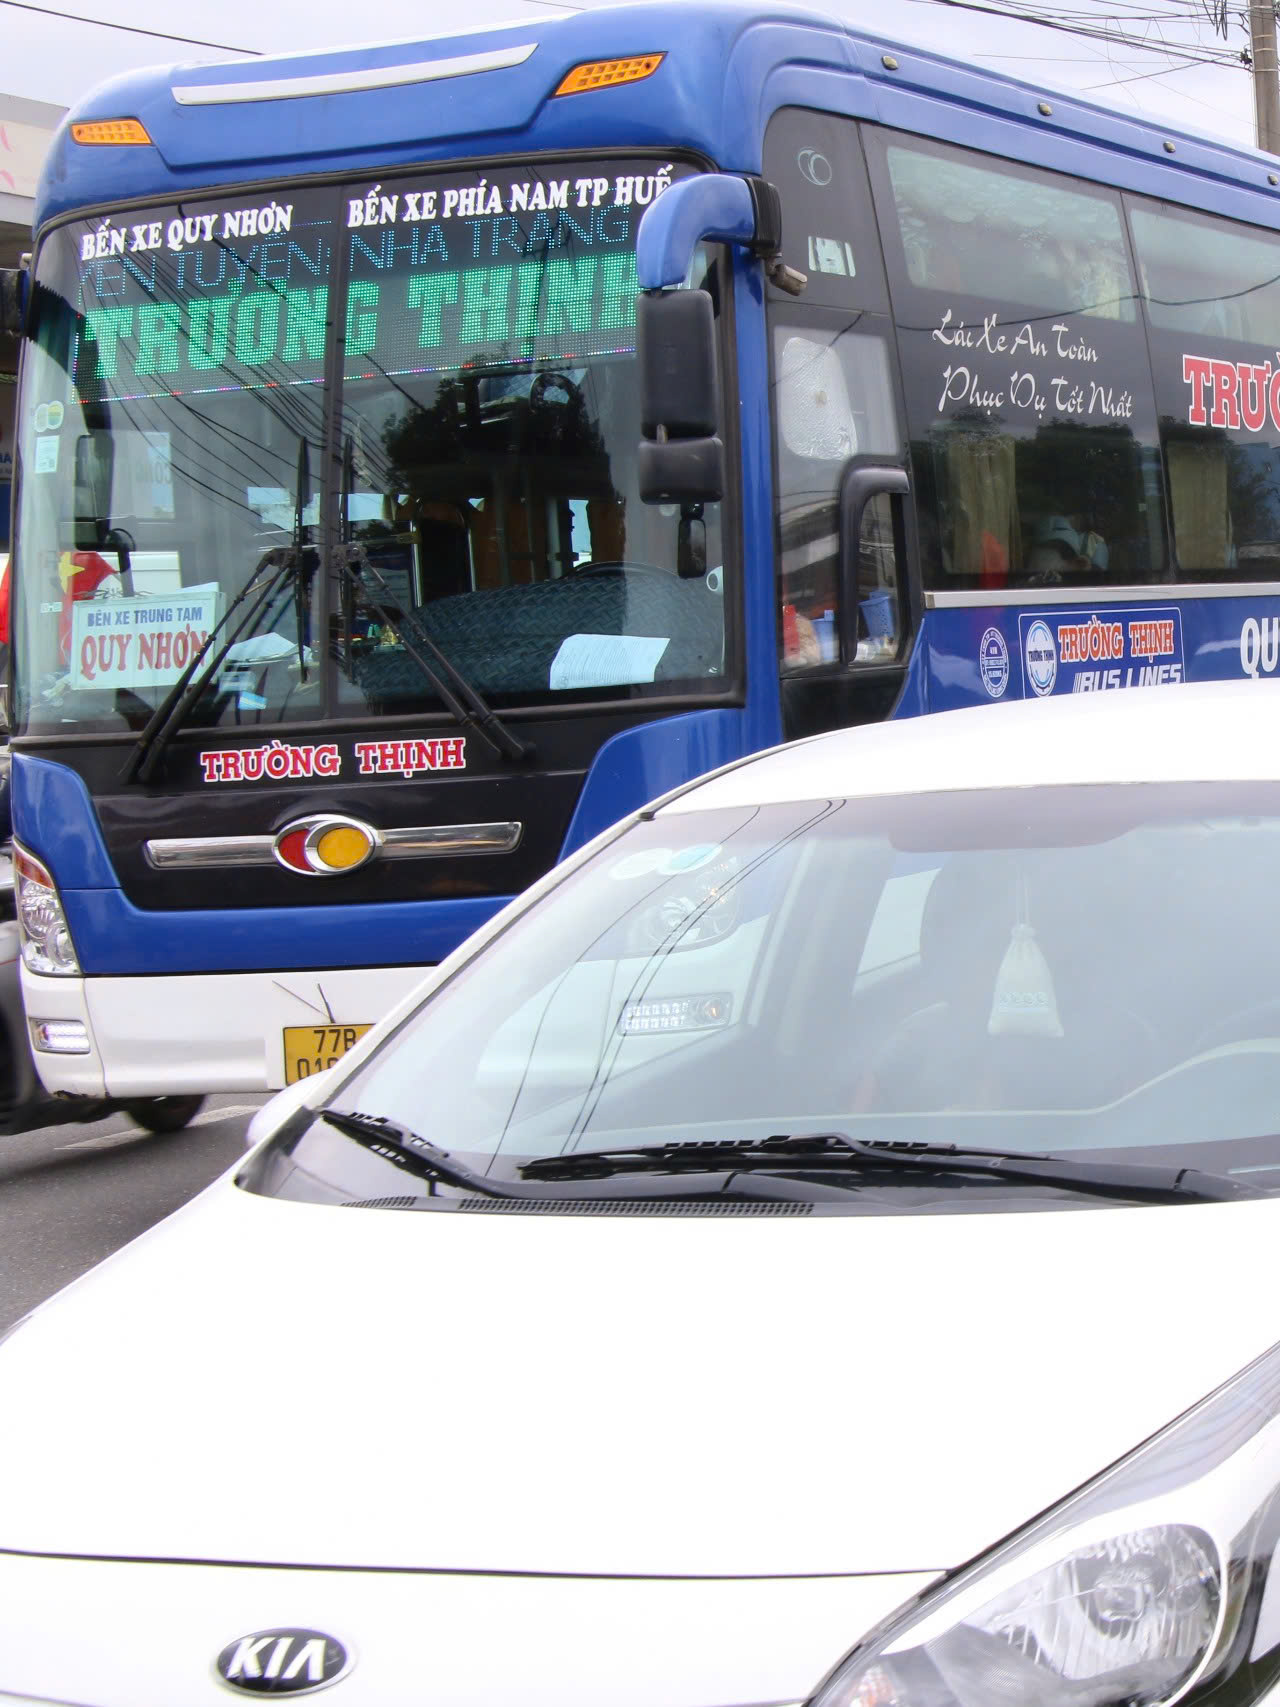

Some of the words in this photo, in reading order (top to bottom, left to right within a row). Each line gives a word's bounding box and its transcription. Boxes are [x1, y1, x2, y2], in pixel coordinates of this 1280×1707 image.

[347, 184, 399, 228] BẾN
[402, 191, 437, 222] XE
[442, 179, 503, 218] PHÍA
[510, 179, 570, 212] NAM
[575, 177, 608, 207] TP
[81, 218, 127, 261] BẾN
[130, 222, 162, 252] XE
[167, 214, 218, 251] QUY
[223, 201, 293, 239] NHƠN
[349, 224, 449, 272] NHA
[465, 203, 630, 259] TRANG
[976, 313, 1008, 354] Xe
[1010, 324, 1049, 357] An
[1051, 323, 1098, 362] Toàn
[938, 365, 1004, 415] Phục
[1051, 376, 1084, 414] Tốt
[1088, 381, 1133, 418] Nhất
[114, 610, 131, 625] XE
[133, 609, 173, 624] TRUNG
[1058, 615, 1123, 663] TRƯỜNG
[1128, 620, 1174, 664] THỊNH
[80, 634, 132, 681] QUY
[138, 623, 208, 670] NHƠN
[1076, 669, 1121, 693] BUS
[200, 739, 341, 782] TRƯỜNG
[355, 737, 466, 778] THỊNH
[313, 1028, 357, 1054] 77B
[226, 1636, 326, 1681] KIA
